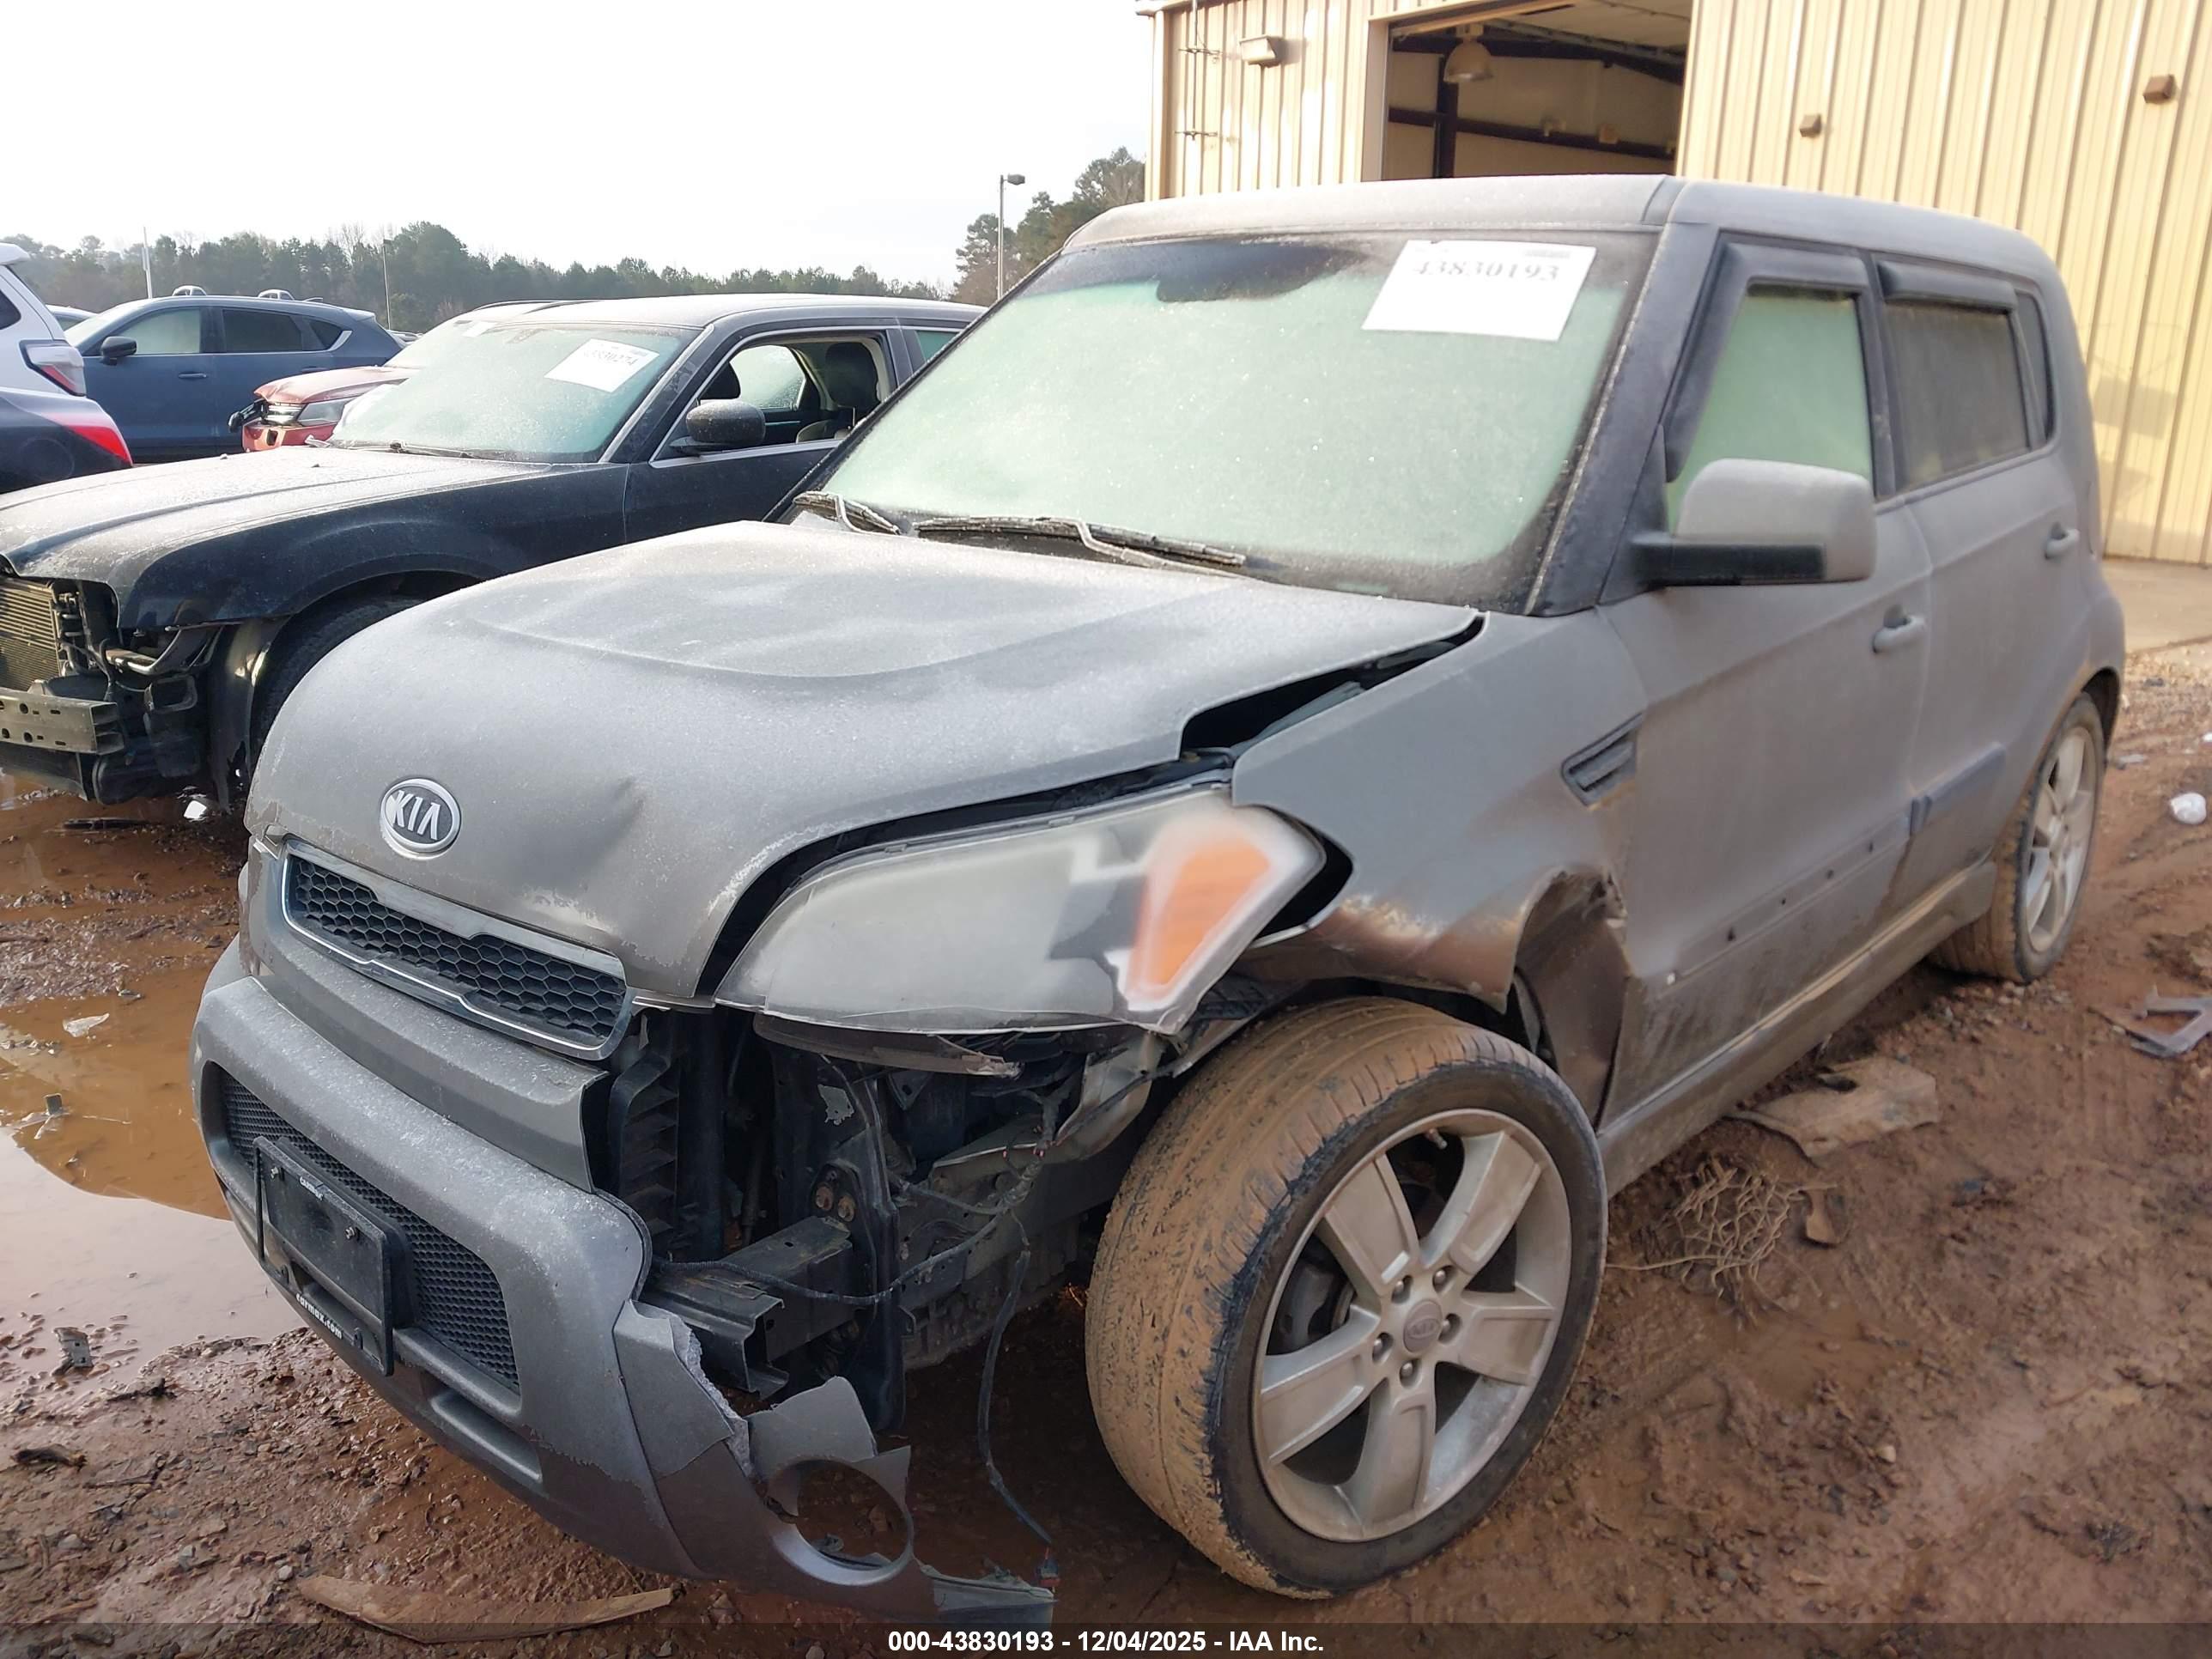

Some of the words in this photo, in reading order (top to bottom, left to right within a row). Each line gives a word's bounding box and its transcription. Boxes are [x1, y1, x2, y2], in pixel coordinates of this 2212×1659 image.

[1413, 260, 1560, 282] 43830193
[393, 789, 441, 841] KIA
[295, 1292, 343, 1340] carmax.com
